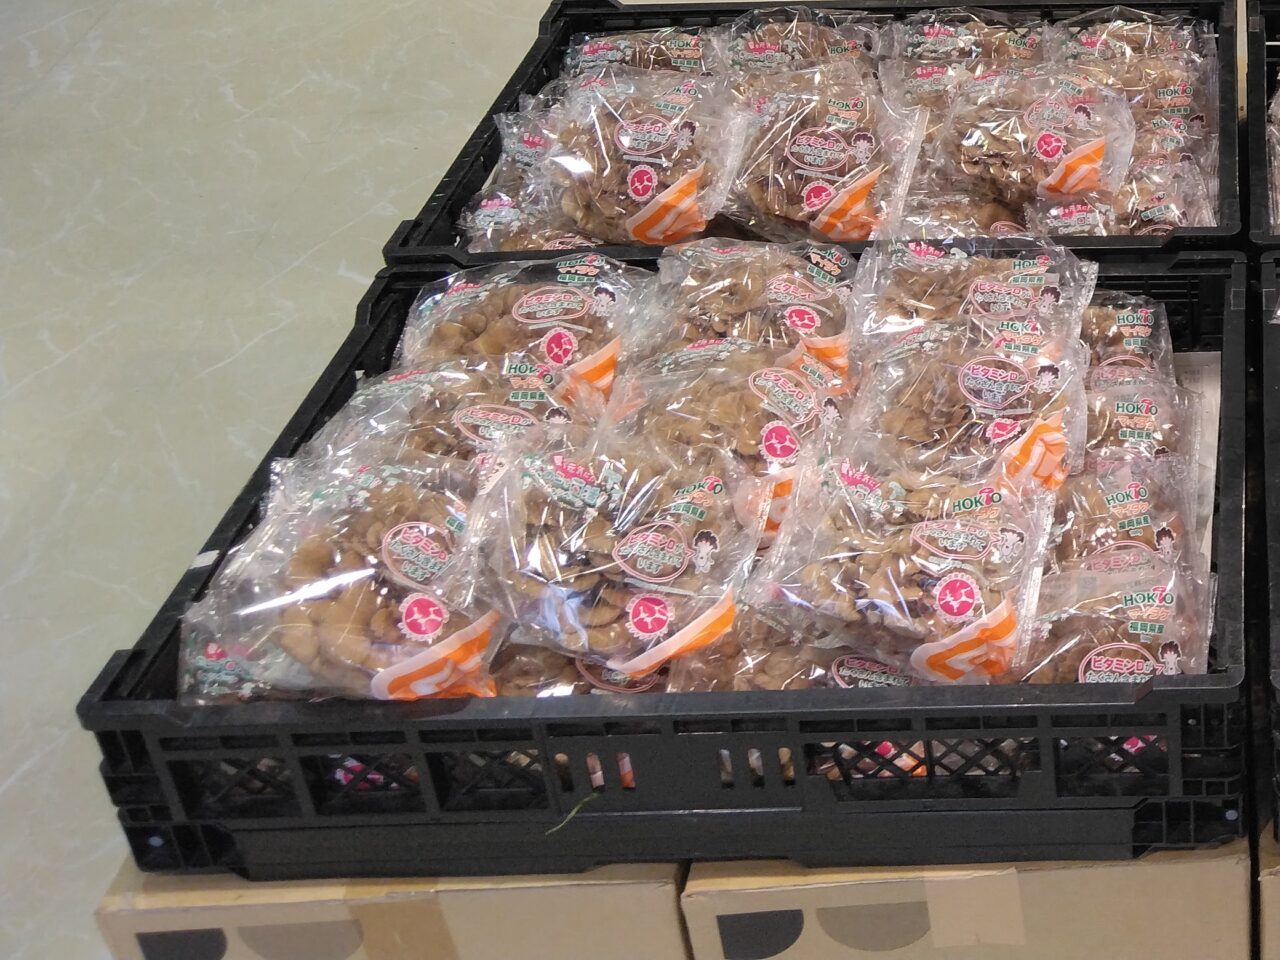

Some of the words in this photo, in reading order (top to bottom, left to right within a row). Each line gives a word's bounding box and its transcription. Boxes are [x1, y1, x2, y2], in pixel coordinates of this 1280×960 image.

[1116, 309, 1154, 326] HOKTO
[1116, 398, 1158, 416] HOKTO
[952, 487, 1003, 513] HOKTO
[1105, 481, 1149, 506] HOKTO
[1123, 586, 1176, 607] HOKTO
